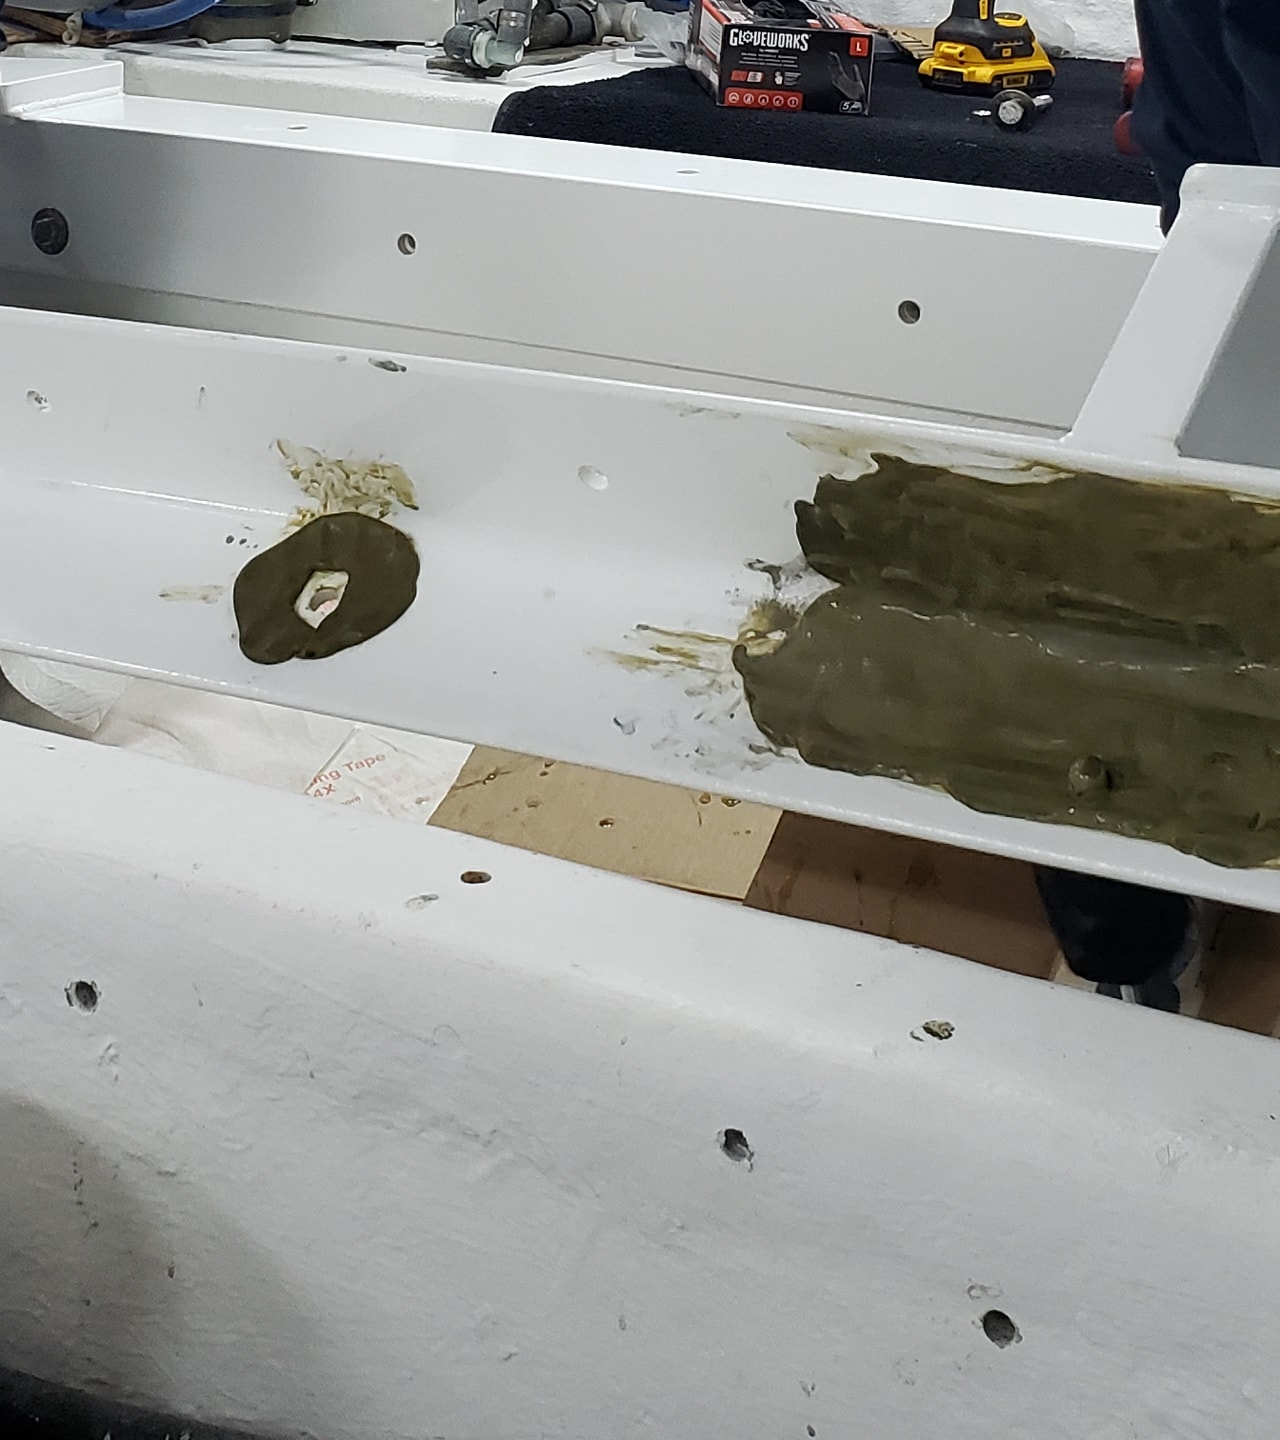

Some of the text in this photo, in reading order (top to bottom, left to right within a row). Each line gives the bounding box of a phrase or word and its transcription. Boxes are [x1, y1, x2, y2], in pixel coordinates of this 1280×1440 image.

[729, 28, 809, 52] GLOVEWORKS
[855, 41, 862, 52] L
[342, 753, 386, 772] Tape
